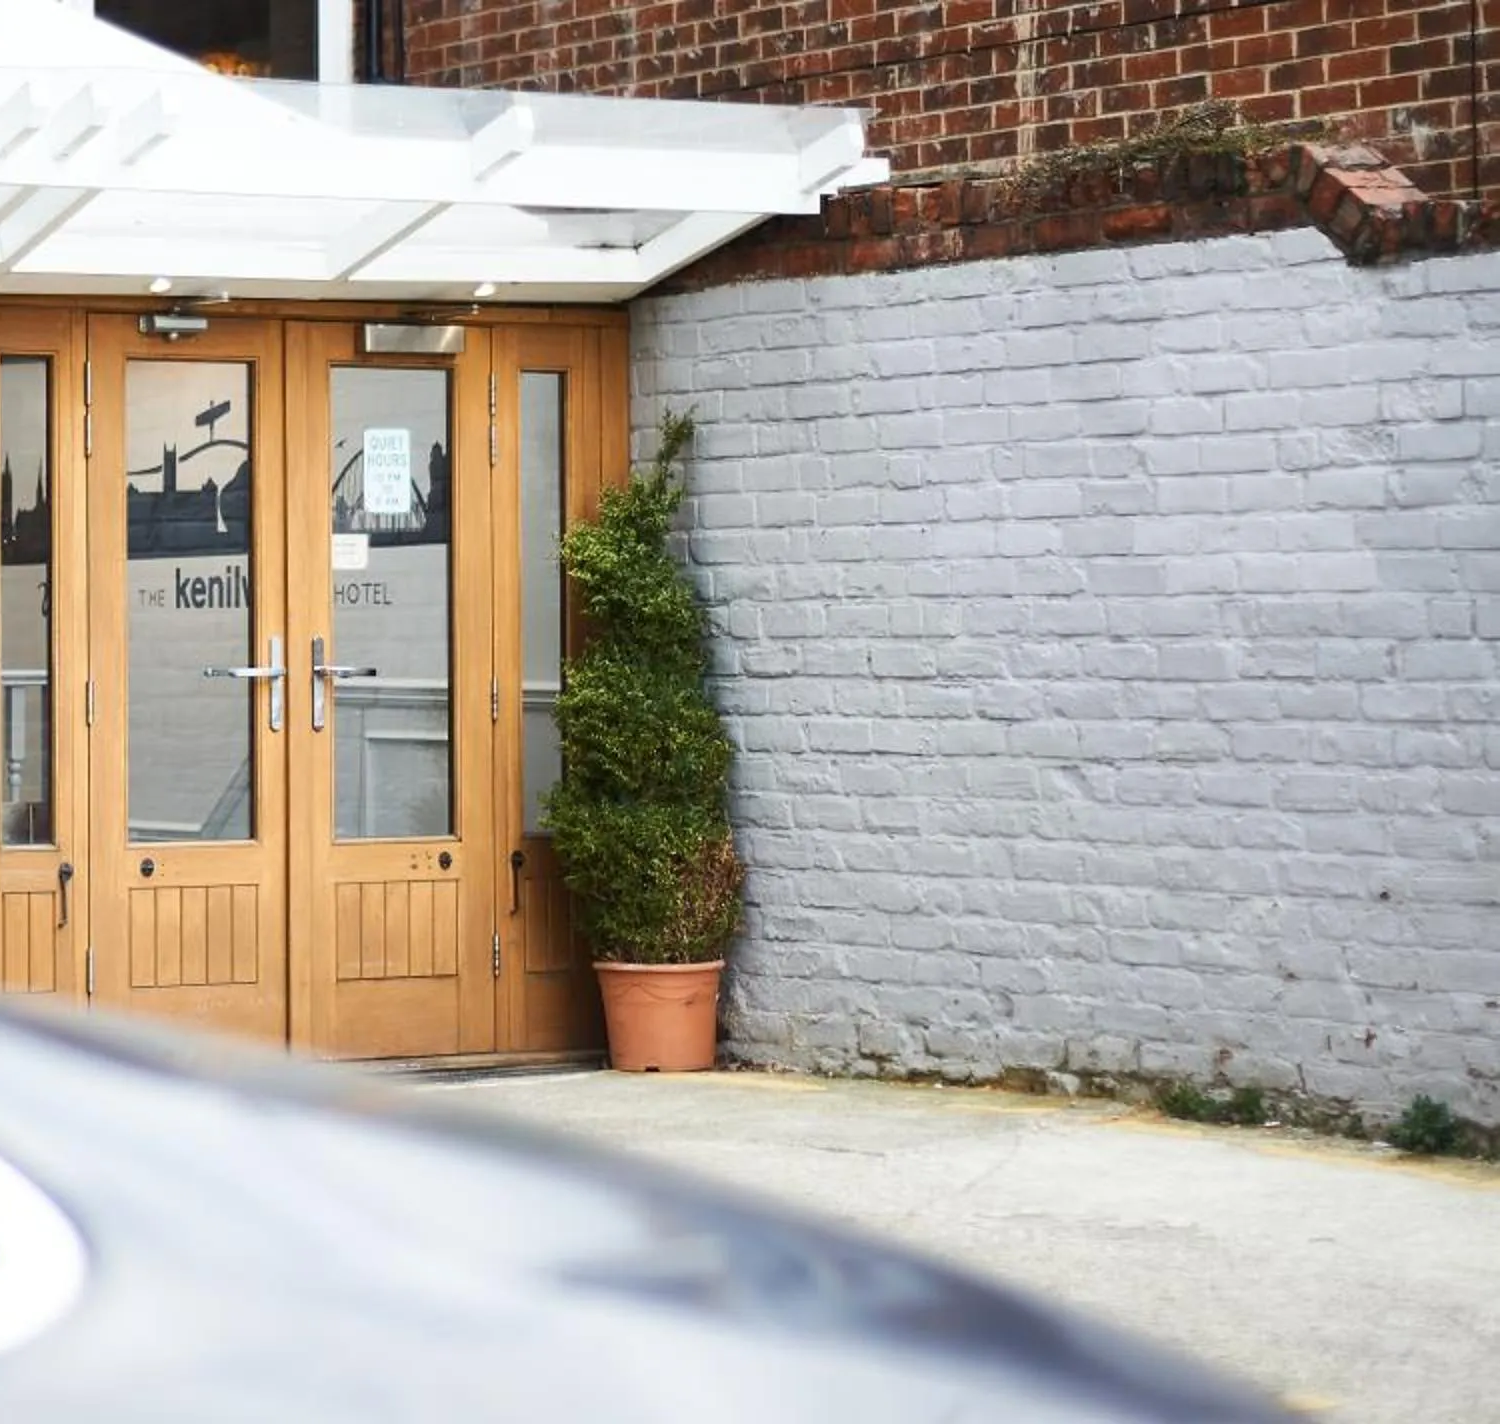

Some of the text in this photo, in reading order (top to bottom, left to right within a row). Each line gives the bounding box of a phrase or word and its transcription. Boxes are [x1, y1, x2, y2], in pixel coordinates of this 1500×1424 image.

[369, 435, 403, 451] QUIET
[367, 453, 407, 468] HOURS
[138, 589, 165, 607] THE
[332, 582, 393, 606] HOTEL
